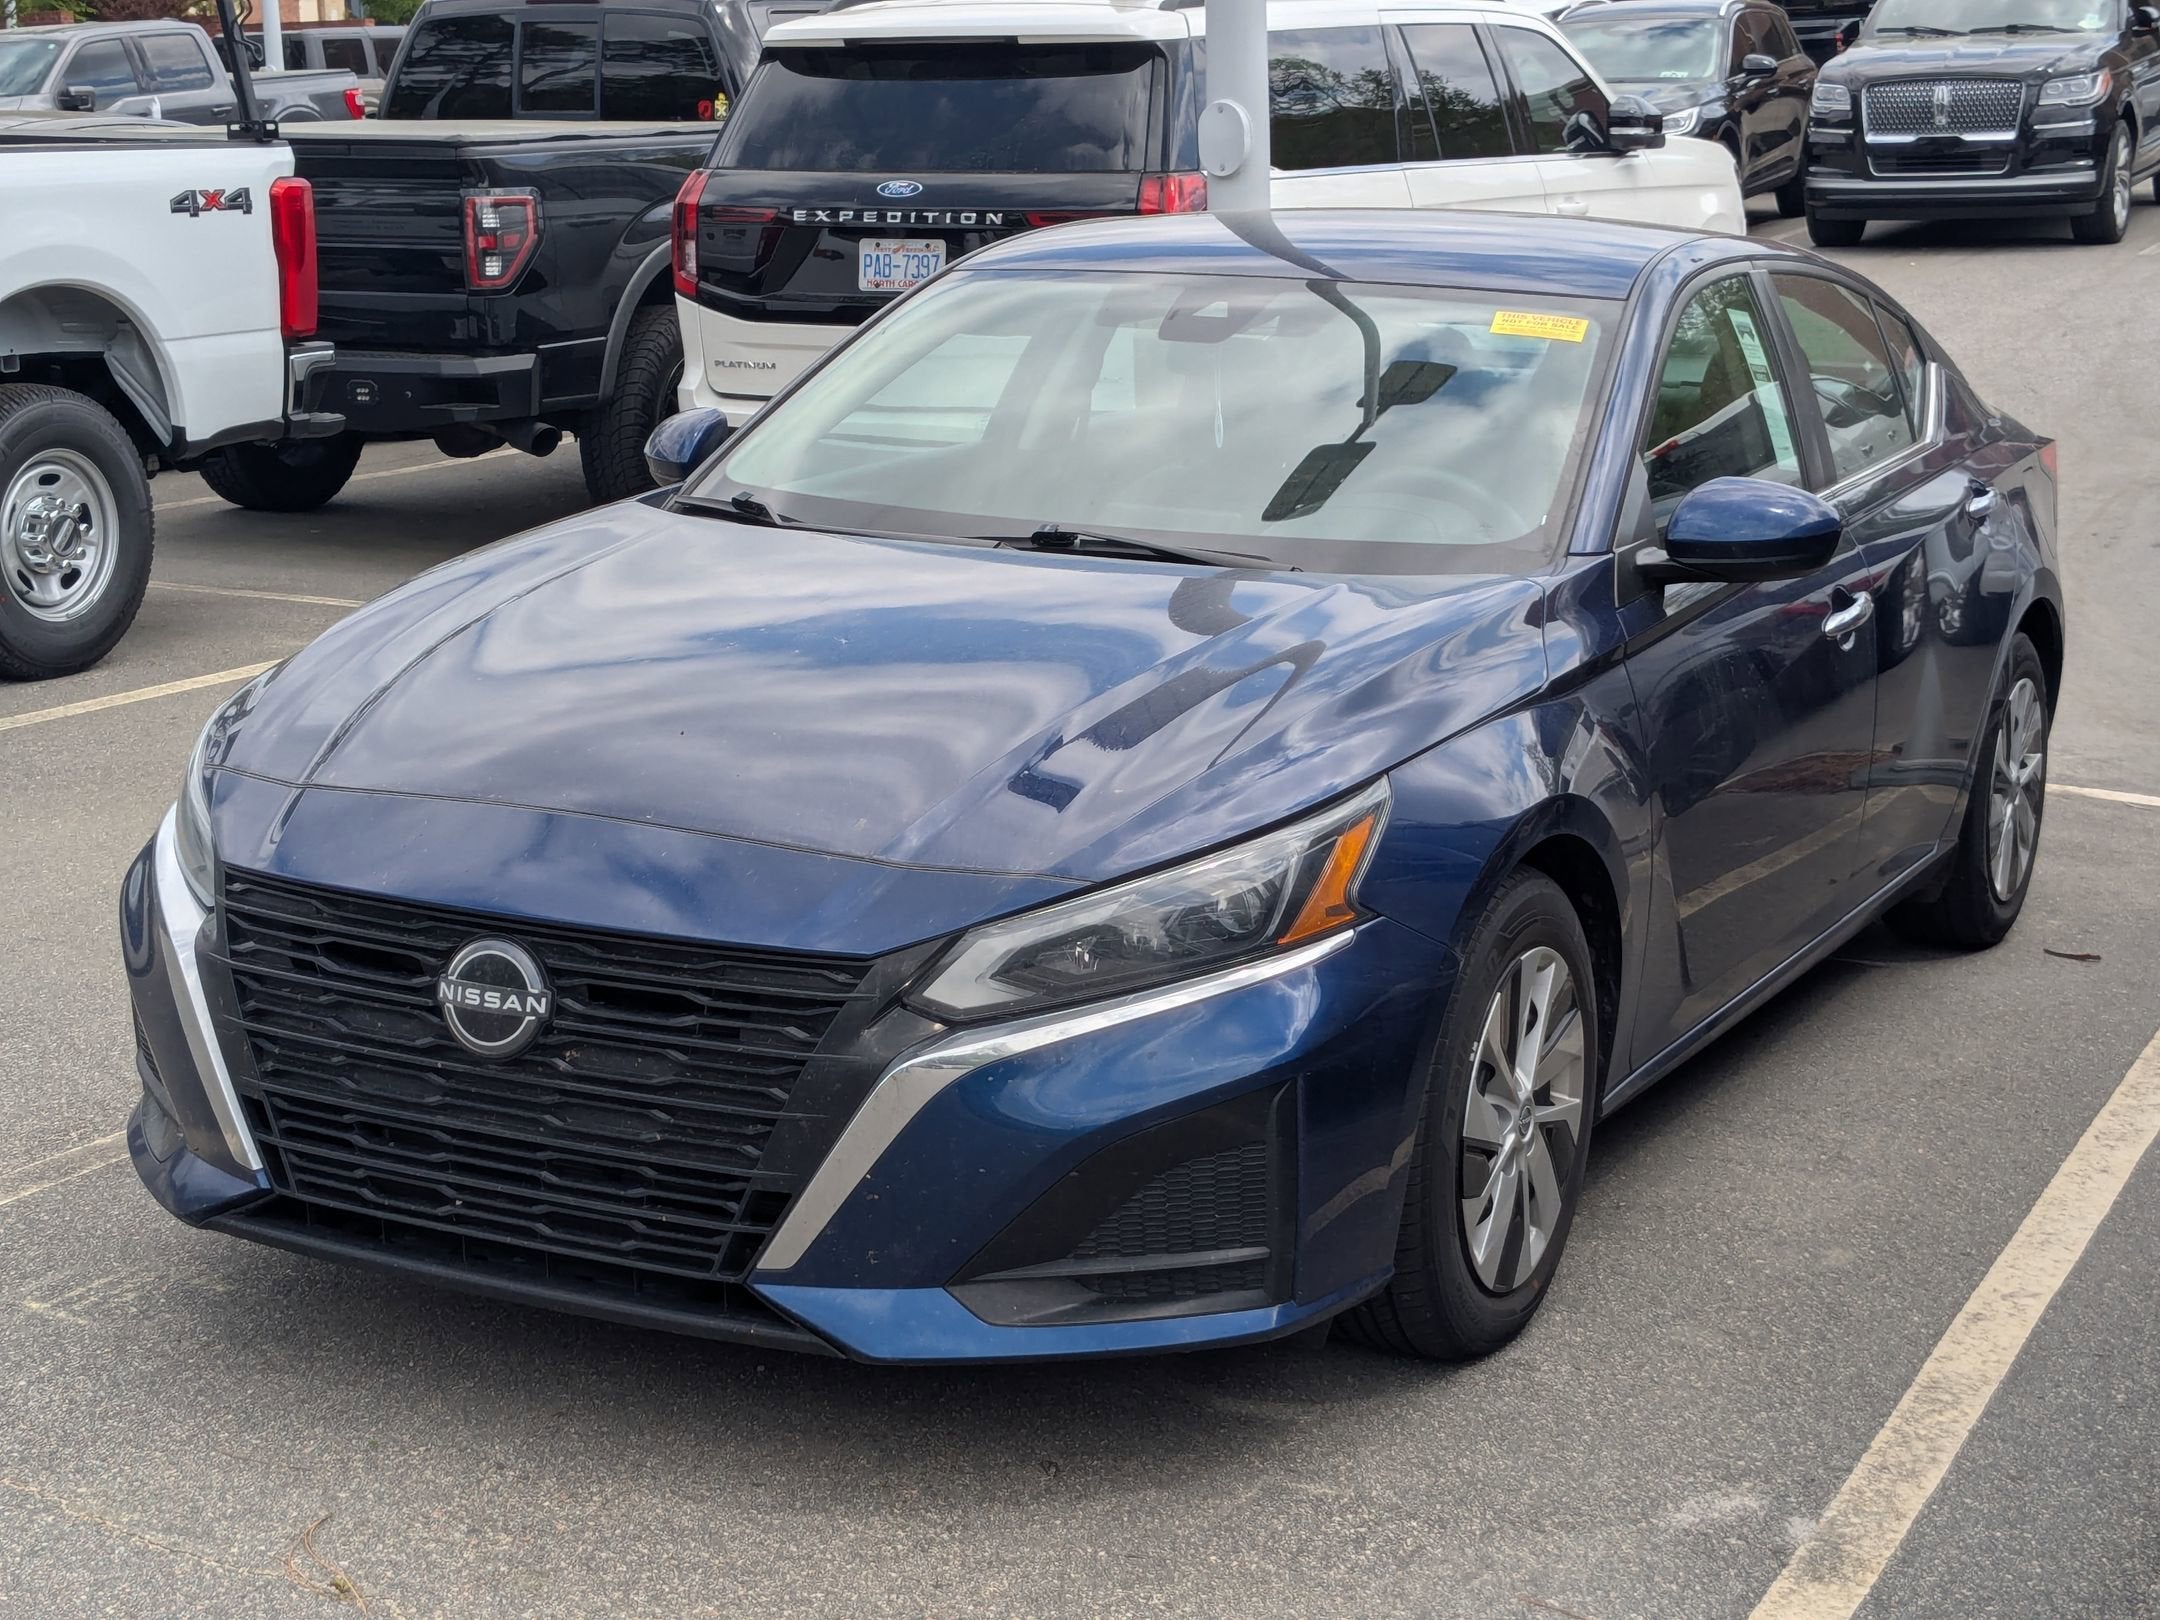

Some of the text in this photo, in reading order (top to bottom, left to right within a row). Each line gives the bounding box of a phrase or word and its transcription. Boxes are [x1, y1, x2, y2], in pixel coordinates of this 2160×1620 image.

[884, 181, 915, 195] Ford
[793, 210, 1003, 225] EXPEDITION
[863, 253, 940, 279] PAB-7397
[866, 280, 895, 288] NORTH
[1501, 312, 1583, 325] THIS VEHICLE
[714, 359, 776, 370] PLATINUM
[439, 981, 547, 1014] NISSAN
